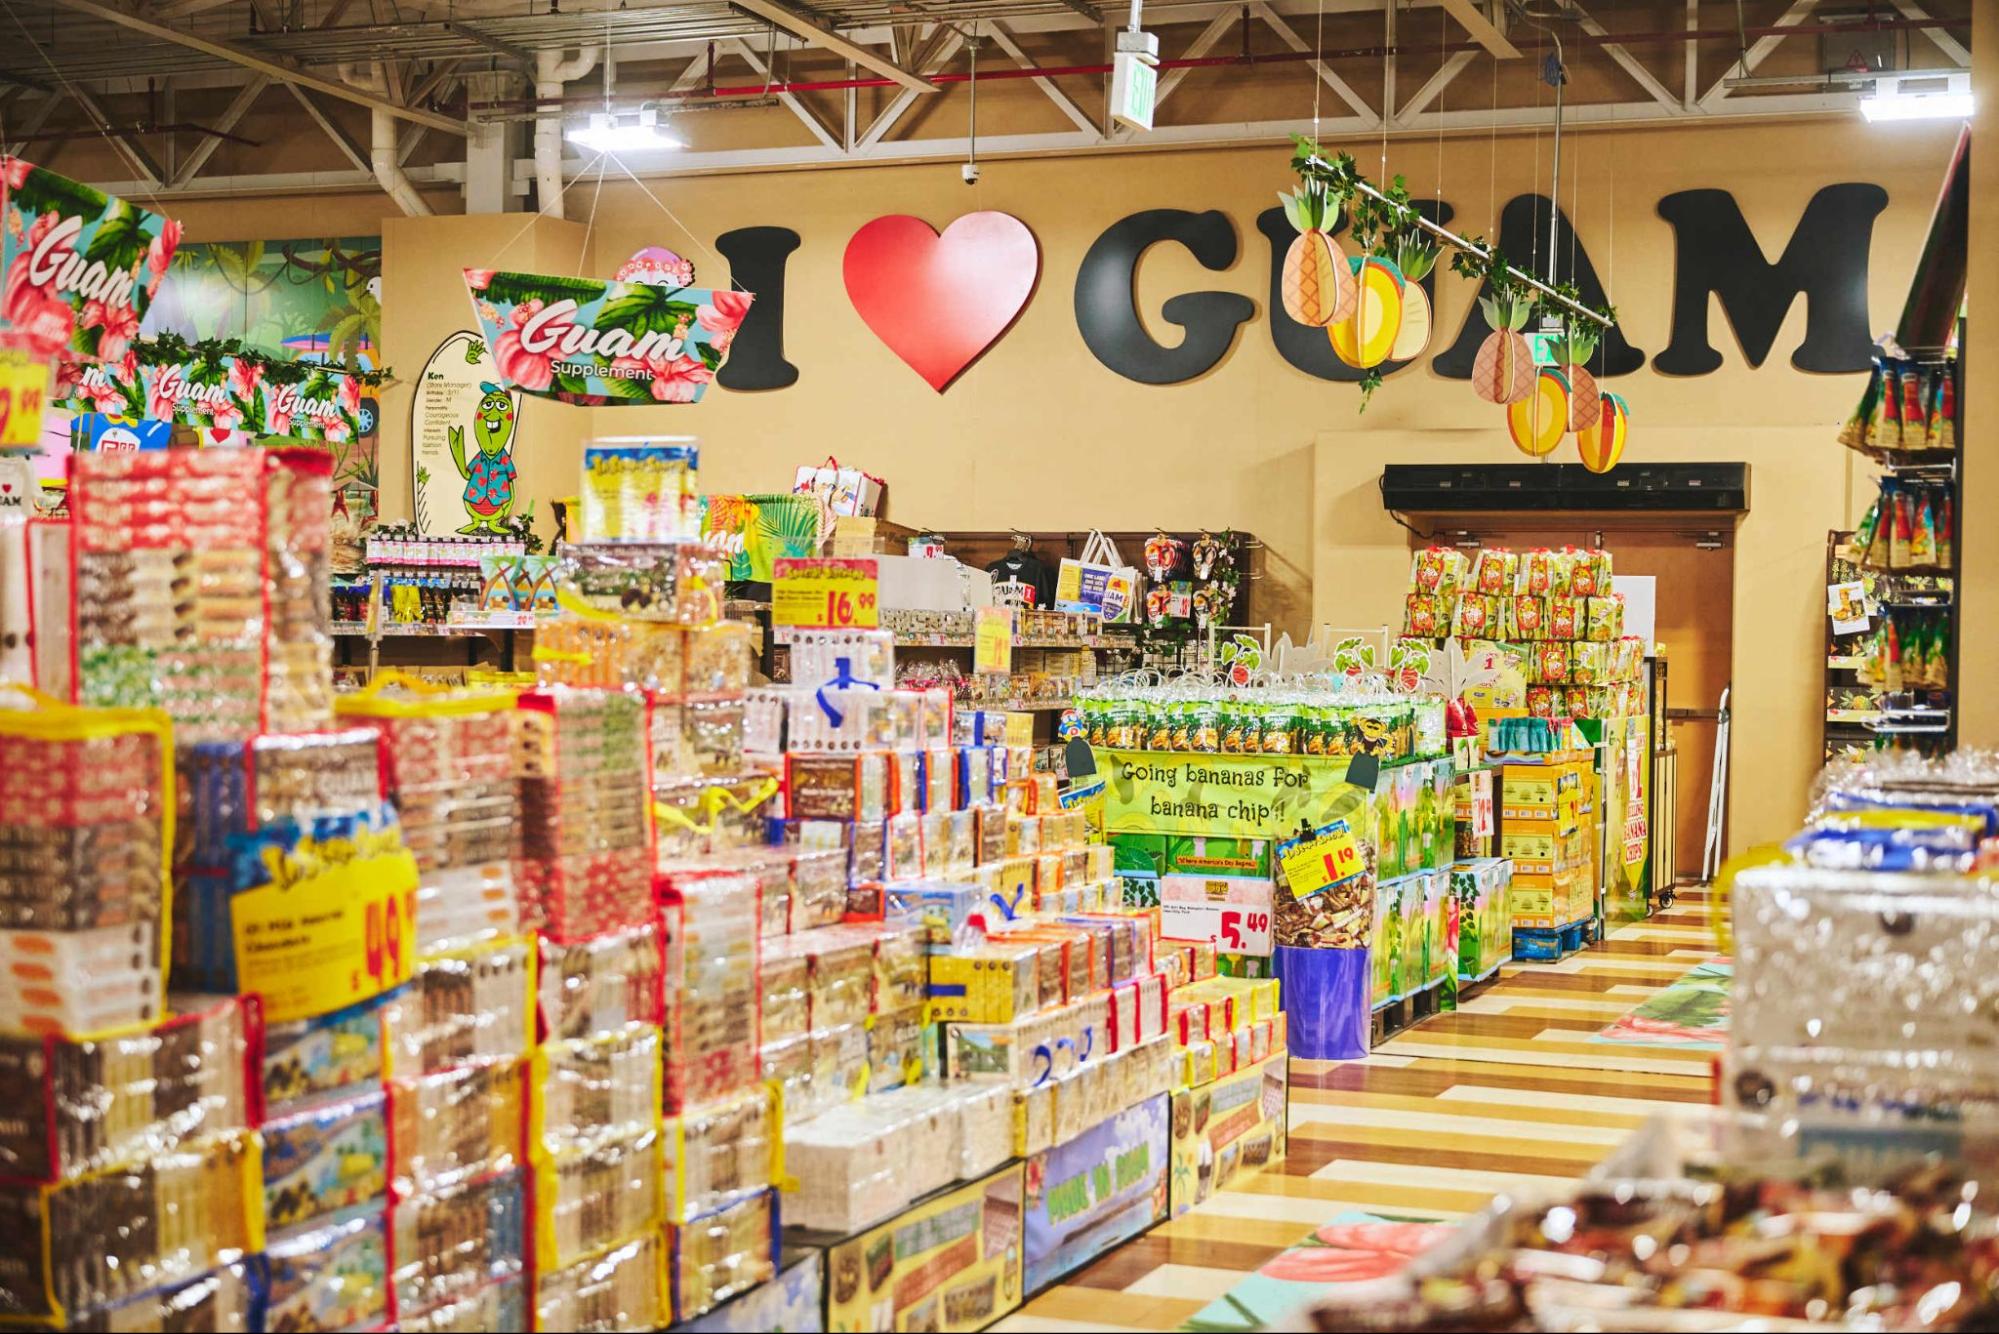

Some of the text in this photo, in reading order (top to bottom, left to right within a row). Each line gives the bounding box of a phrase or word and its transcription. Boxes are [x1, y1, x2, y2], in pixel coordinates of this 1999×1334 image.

[29, 214, 134, 309] Guam
[715, 181, 1888, 390] I GUAM
[519, 299, 687, 362] Guam
[158, 362, 227, 402] Guam
[427, 372, 444, 380] Ken
[550, 360, 653, 381] Supplement
[171, 402, 215, 417] Supplement
[276, 384, 338, 418] Guam
[287, 416, 326, 429] Supplement
[1121, 761, 1177, 788] Going
[1186, 763, 1265, 788] bananas
[1151, 796, 1219, 820] banana
